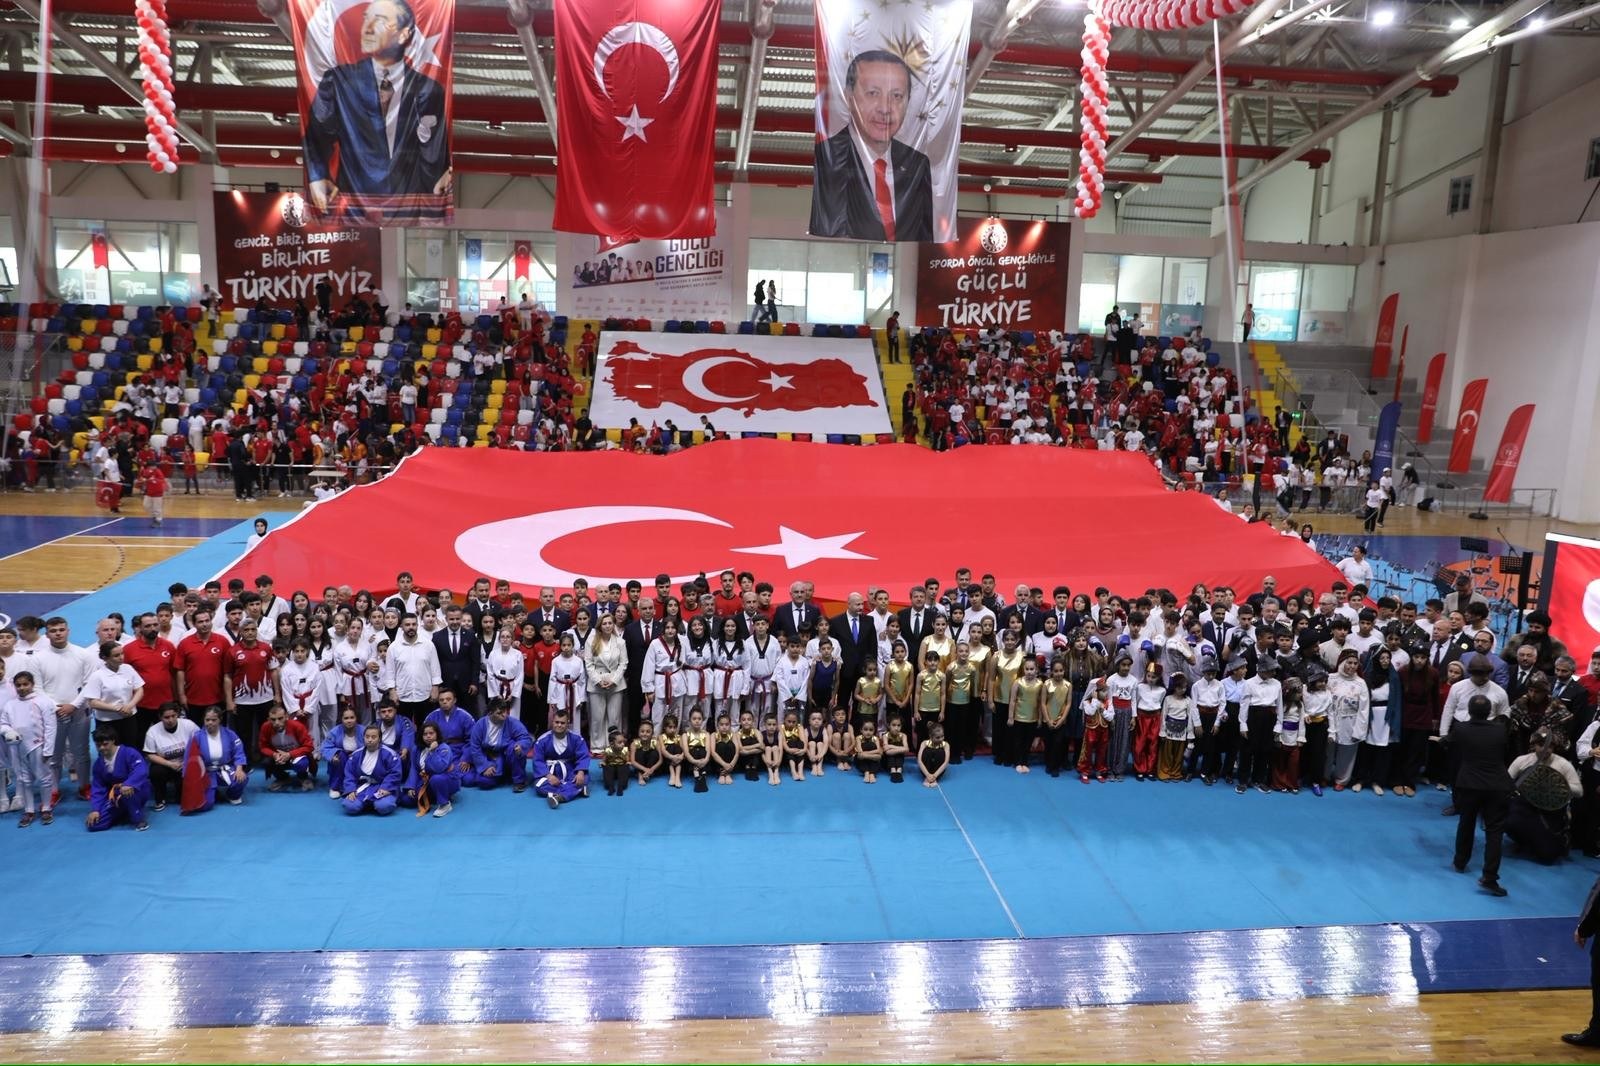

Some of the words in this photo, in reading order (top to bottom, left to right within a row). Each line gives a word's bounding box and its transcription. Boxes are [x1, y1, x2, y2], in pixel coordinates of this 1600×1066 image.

[276, 232, 304, 246] BİRİZ,
[307, 229, 360, 244] BERABERİZ
[261, 247, 331, 268] BİRLİKTE
[655, 249, 724, 273] GENÇLİĞİ
[929, 257, 965, 269] SPORDA
[967, 254, 996, 267] ÖNCÜ,
[998, 252, 1056, 267] GENÇLİĞİYLE
[225, 266, 373, 304] TÜRKİYE'YİZ
[957, 266, 1027, 294] GÜÇLÜ
[938, 295, 1032, 328] TÜRKİYE
